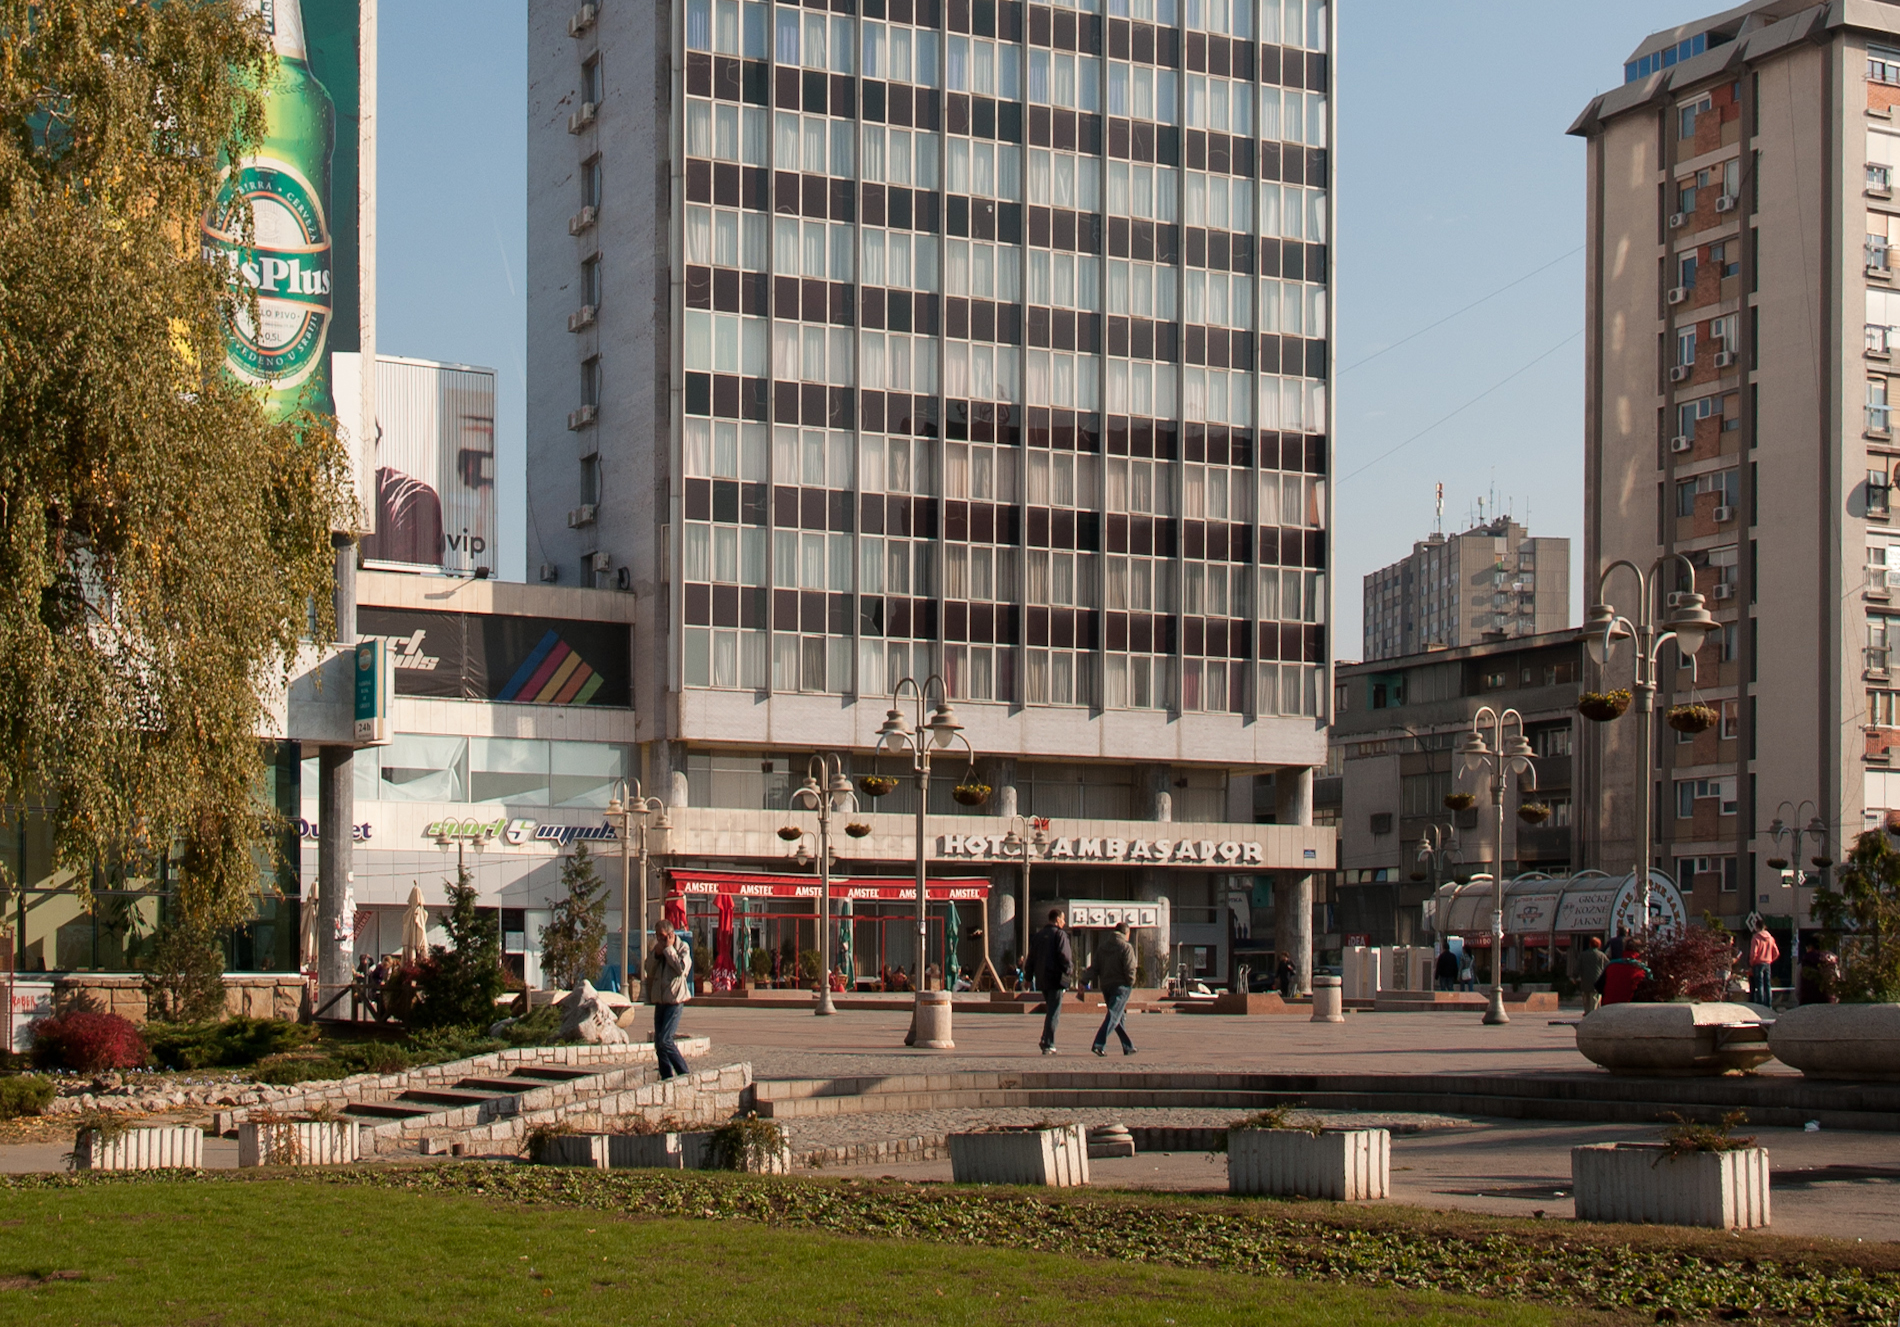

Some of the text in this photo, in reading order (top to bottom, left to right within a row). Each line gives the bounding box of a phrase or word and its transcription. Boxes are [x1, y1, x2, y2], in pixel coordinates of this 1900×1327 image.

[285, 191, 319, 243] CERVEZA
[446, 527, 487, 559] vip
[1051, 836, 1264, 862] AMBASADOR
[684, 881, 980, 899] AMSTEL AMSTEL AMSTE AMSTEL AMSL AMSTEL
[1578, 894, 1611, 904] GRČKE
[1574, 905, 1609, 915] KOŽNE
